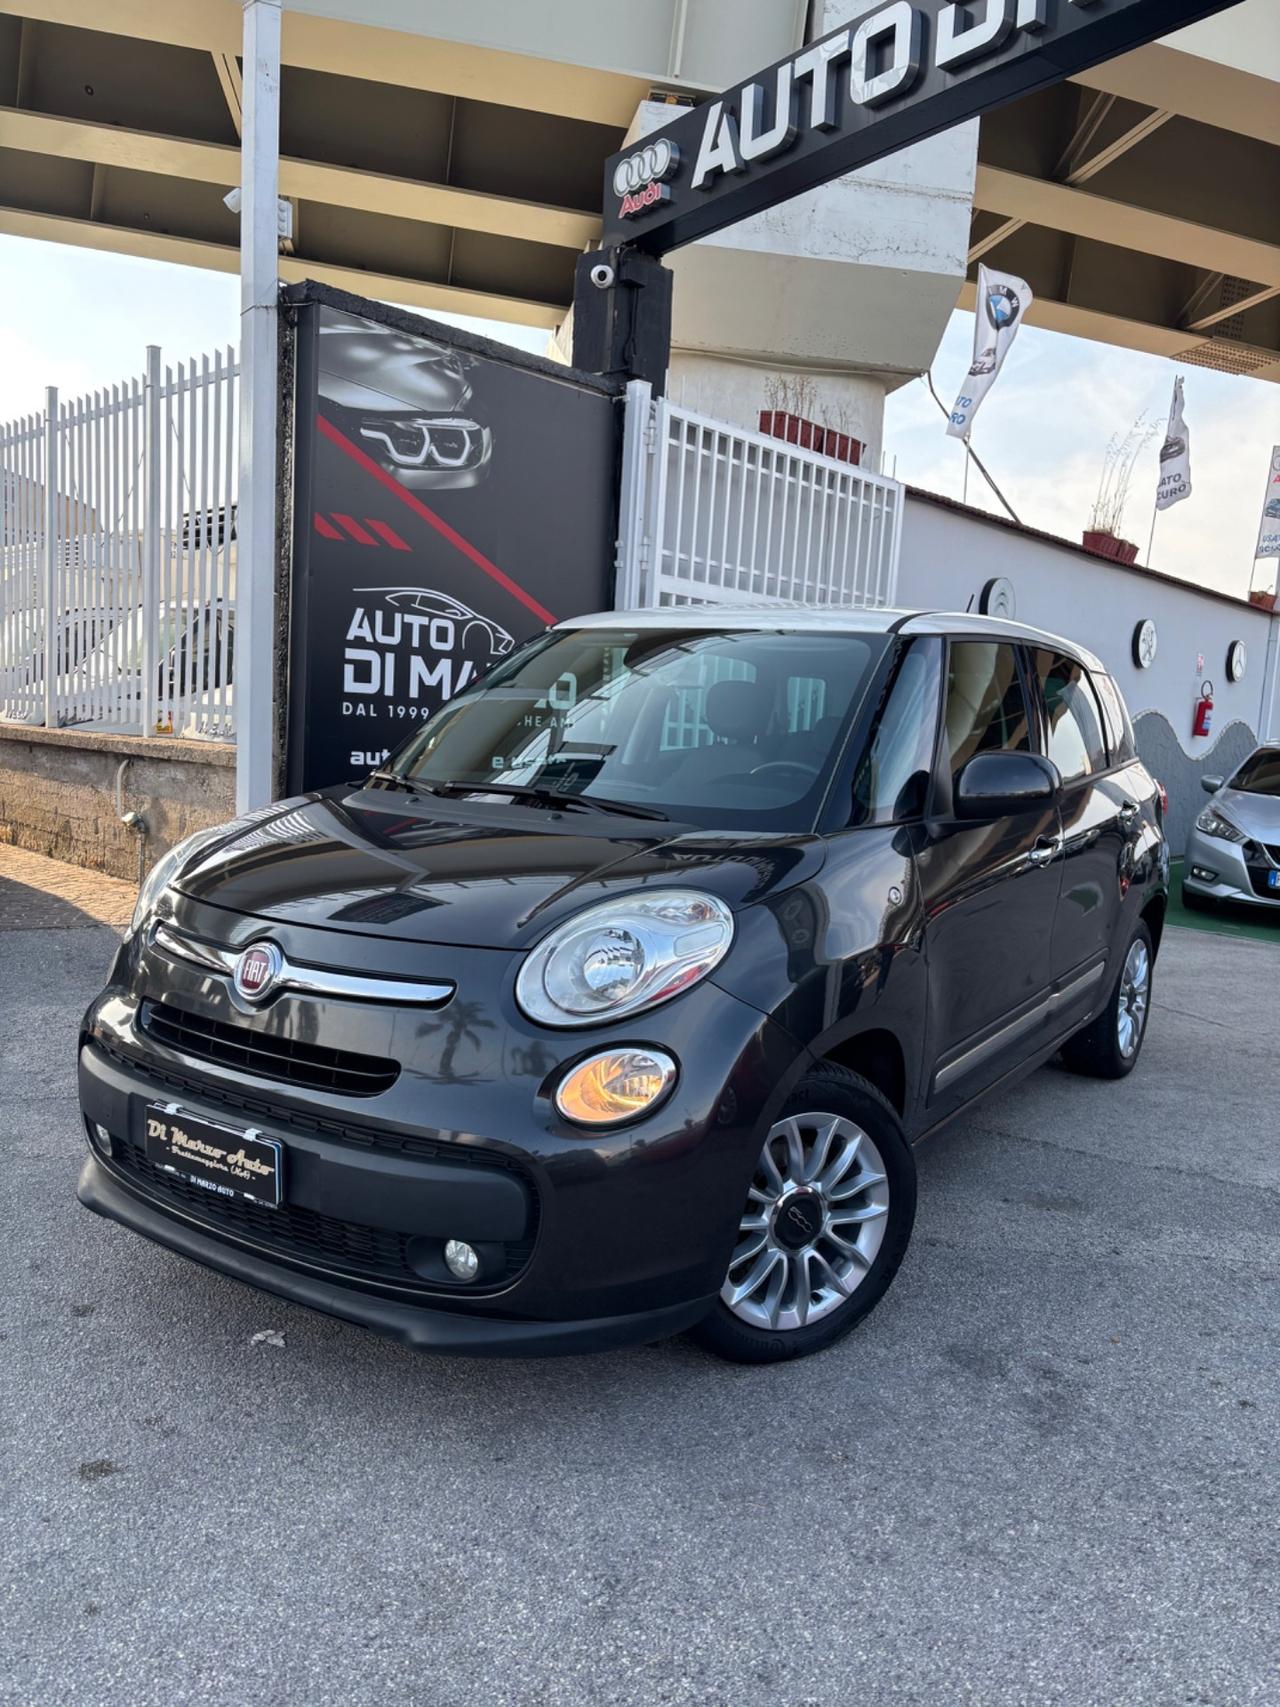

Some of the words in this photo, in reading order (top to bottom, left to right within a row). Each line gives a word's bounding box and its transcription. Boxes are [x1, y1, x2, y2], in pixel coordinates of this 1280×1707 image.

[691, 3, 916, 189] AUTO
[346, 607, 455, 652] AUTO
[344, 648, 396, 697] DI
[342, 702, 378, 717] DAL
[388, 705, 430, 720] 1999
[243, 959, 267, 983] FIAT
[197, 1178, 217, 1192] MARZO
[217, 1186, 235, 1198] AUTO
